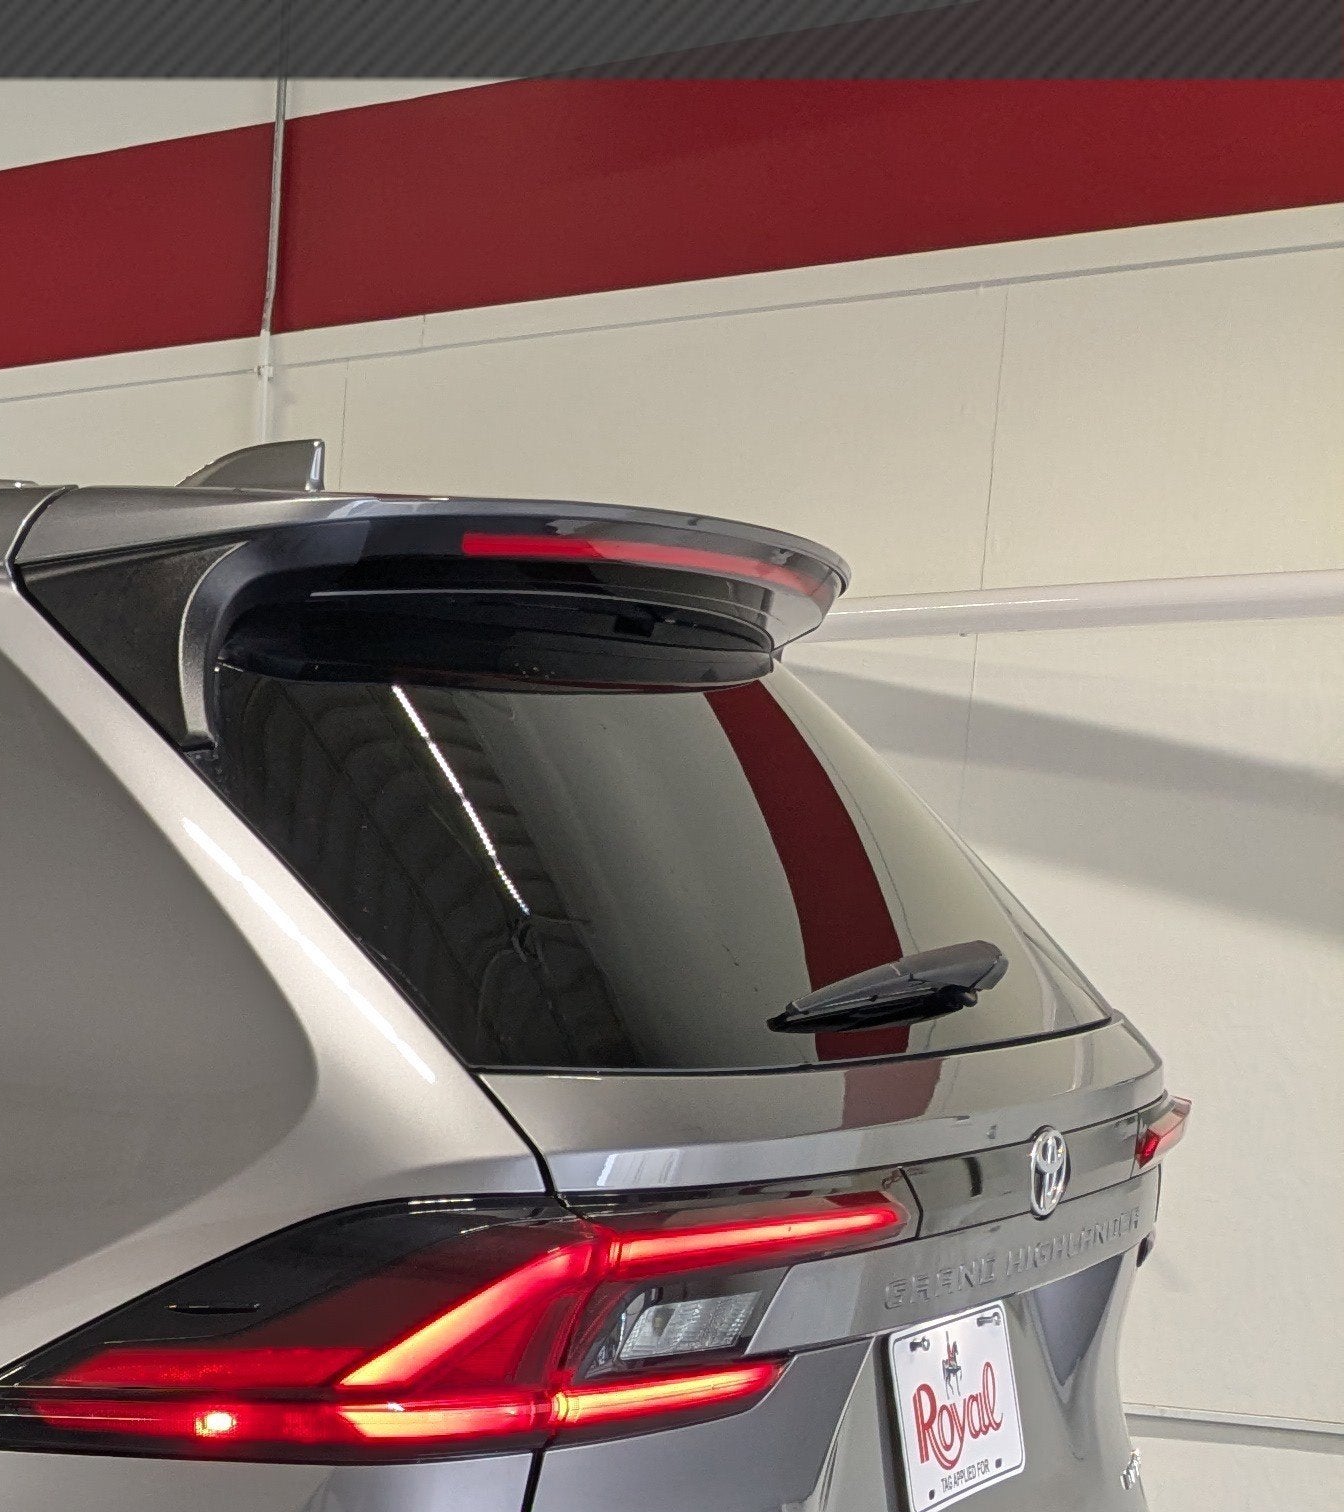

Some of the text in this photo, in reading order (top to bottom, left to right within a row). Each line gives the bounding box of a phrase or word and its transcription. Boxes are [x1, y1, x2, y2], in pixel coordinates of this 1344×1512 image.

[885, 1206, 1142, 1310] GRAND HIGHLANDER
[913, 1361, 1003, 1471] Royal
[977, 1458, 991, 1478] FOR
